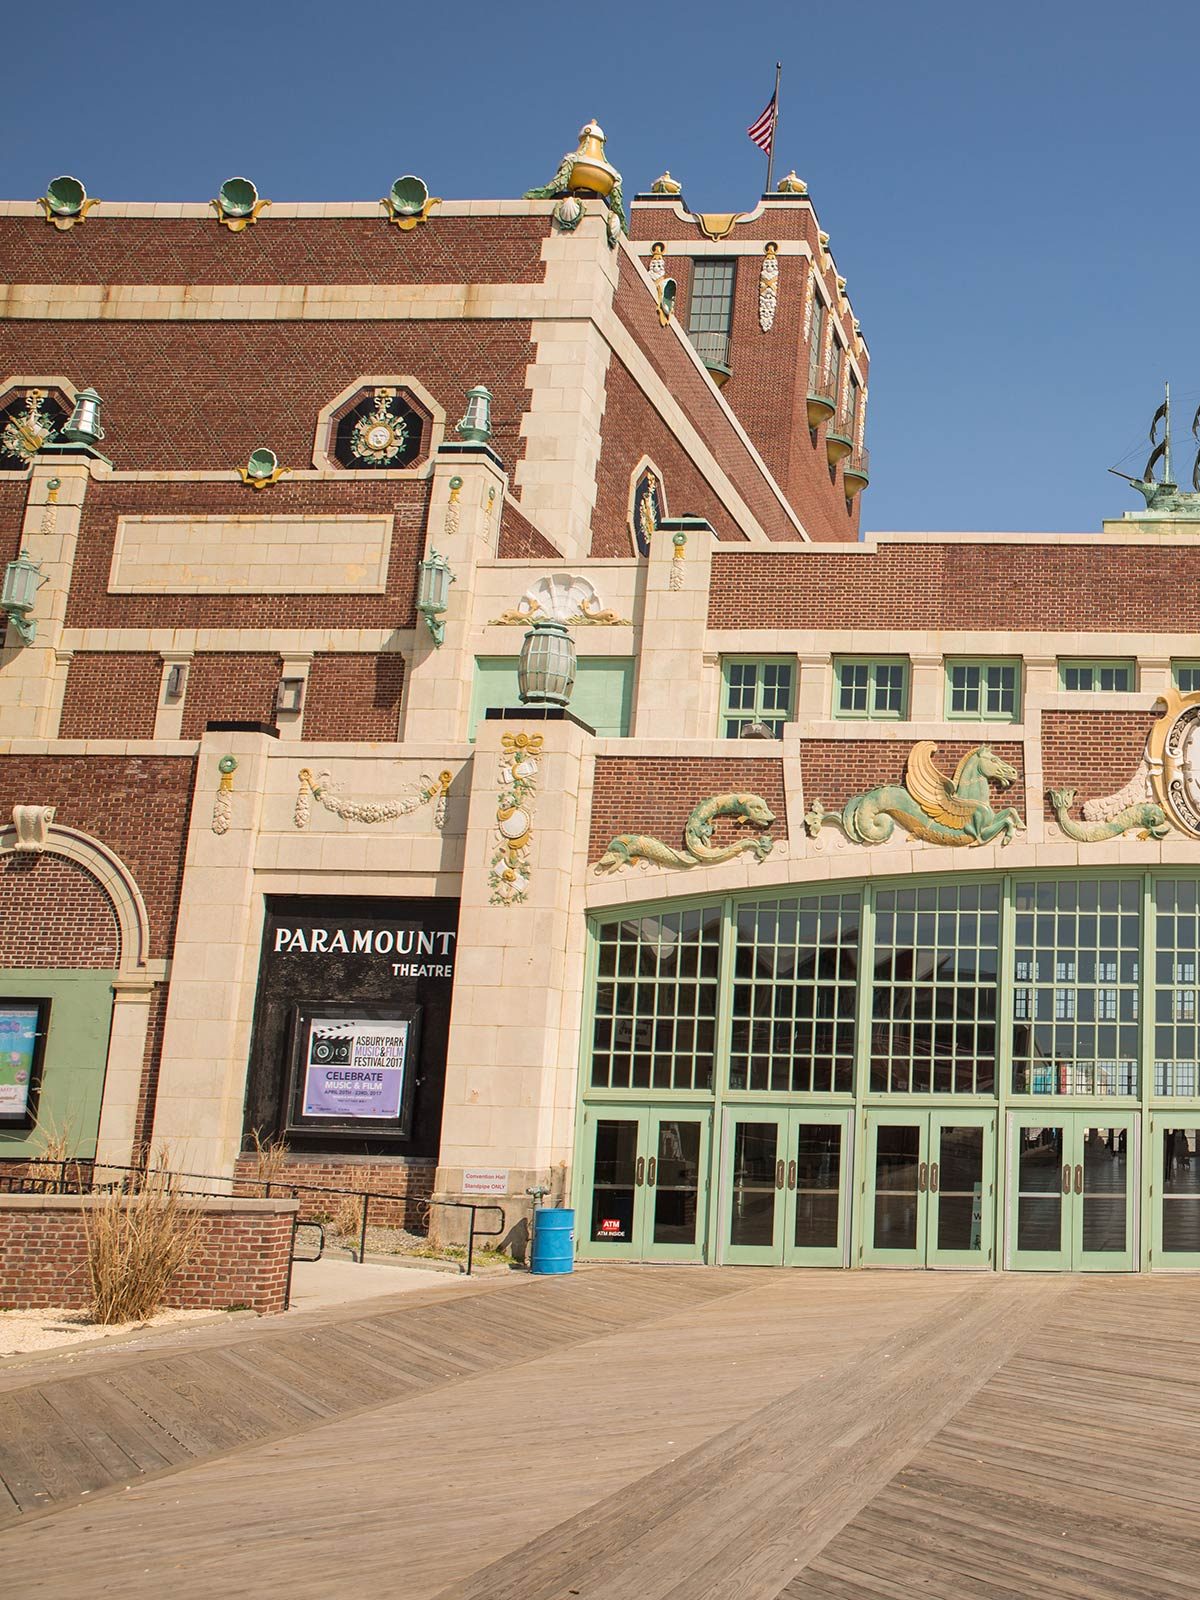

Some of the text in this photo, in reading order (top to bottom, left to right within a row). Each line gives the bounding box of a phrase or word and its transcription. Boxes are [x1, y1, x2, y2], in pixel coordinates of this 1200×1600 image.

[274, 928, 455, 955] PARAMOUNT
[392, 963, 452, 977] THEATRE
[356, 1036, 404, 1046] ASBURY PARK
[355, 1046, 380, 1056] MUSIC
[386, 1047, 404, 1057] FILM
[354, 1056, 403, 1067] FESTIVAL 2017
[326, 1071, 383, 1081] CELEBRATE
[325, 1081, 352, 1089] MUSIC
[603, 1220, 620, 1228] ATM
